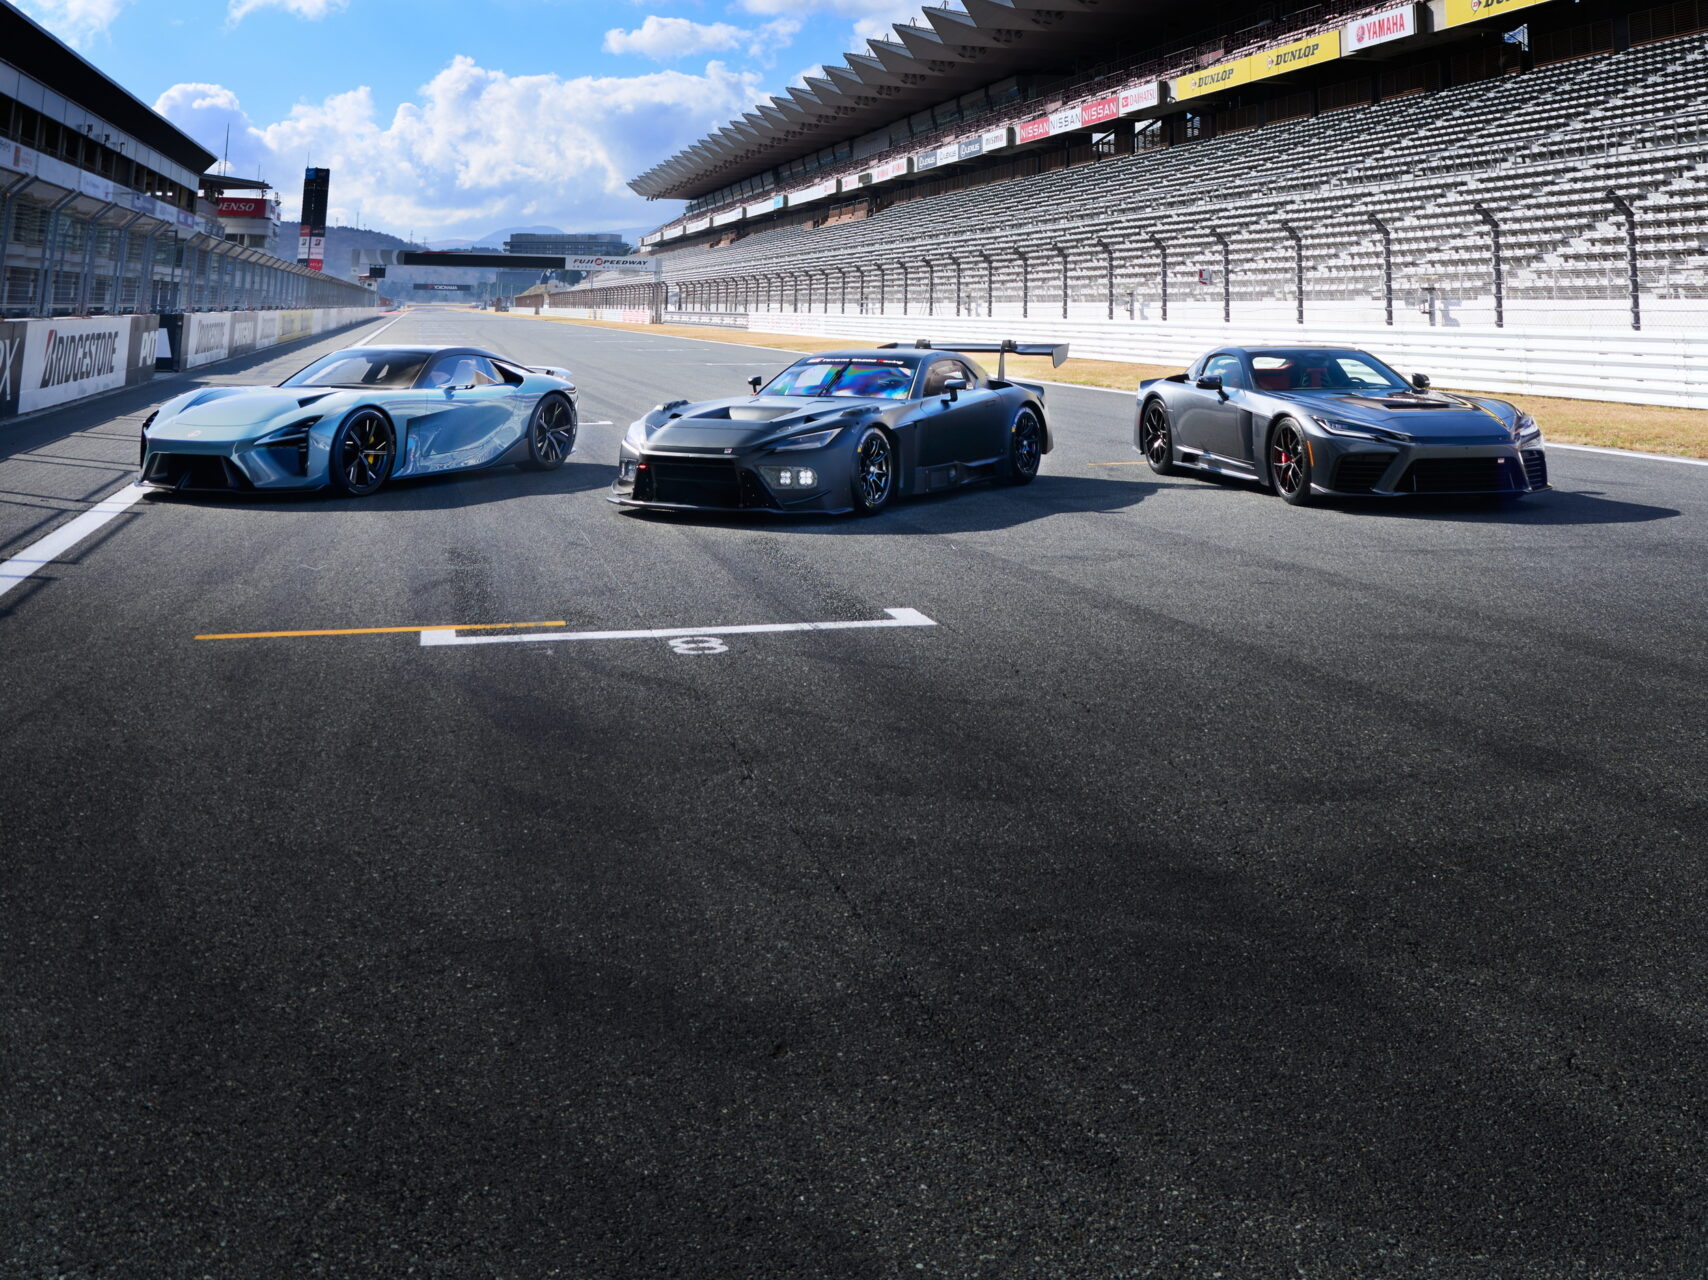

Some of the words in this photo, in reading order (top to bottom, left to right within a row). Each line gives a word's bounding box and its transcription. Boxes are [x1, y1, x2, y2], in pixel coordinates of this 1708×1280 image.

[1366, 13, 1405, 41] YAMAHA
[1274, 43, 1319, 66] DUNLOP
[1197, 68, 1234, 88] DUNLOP
[1082, 102, 1117, 121] NISSAN
[1020, 122, 1049, 138] NISSAN
[1049, 113, 1080, 130] NISSAN
[219, 201, 255, 212] ENSO
[40, 329, 119, 388] BRIDGESTONE
[668, 636, 729, 655] 8
